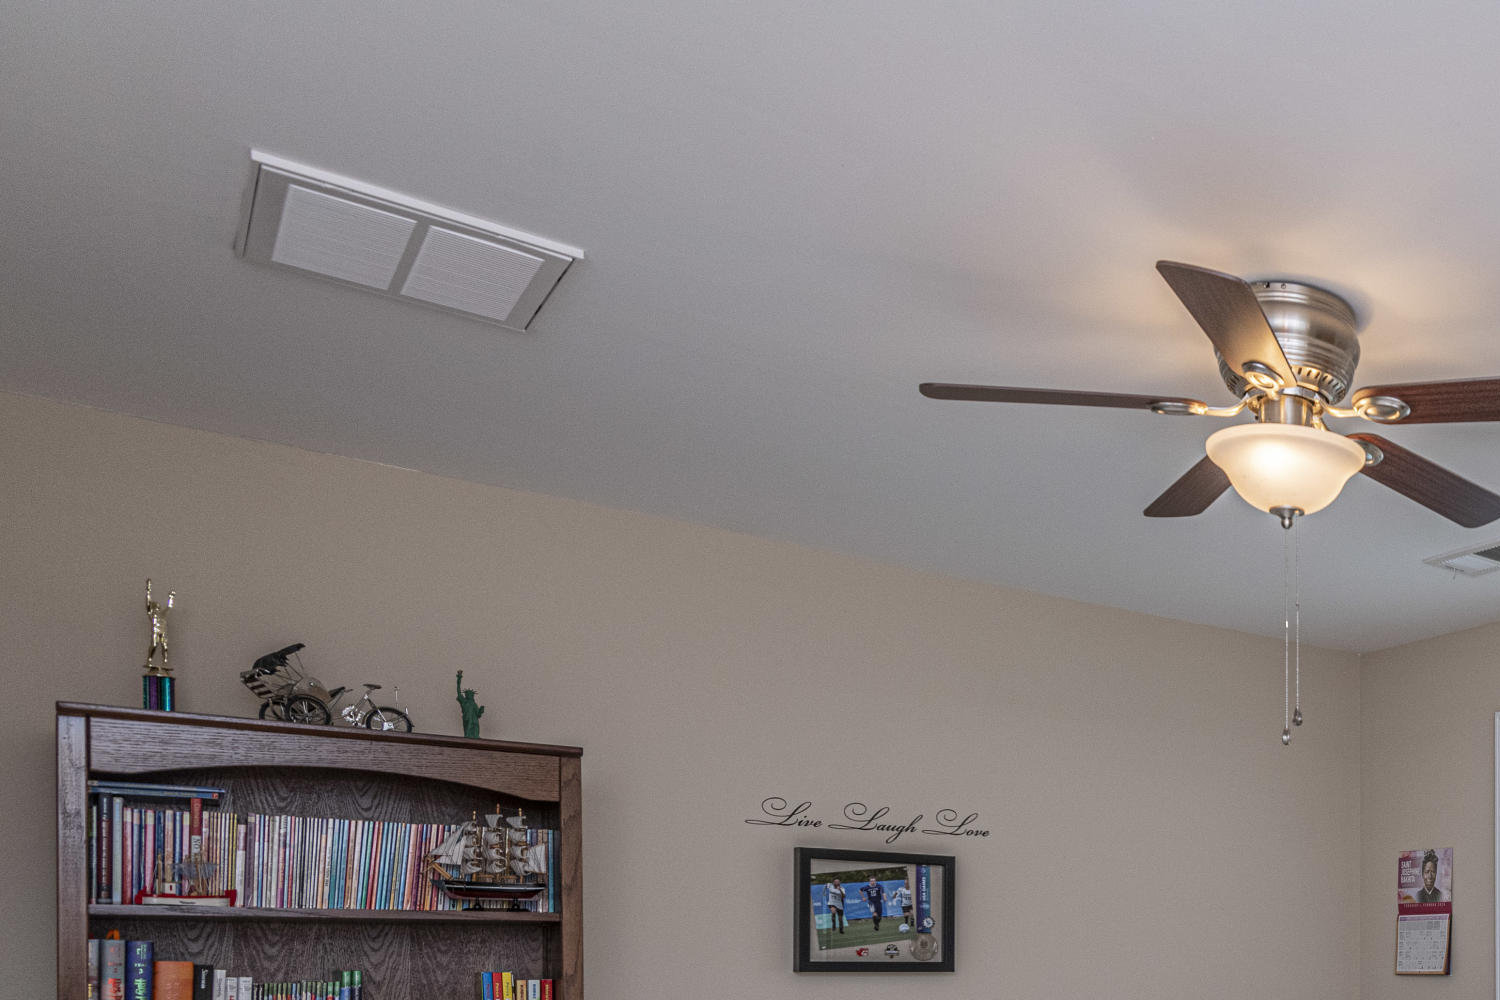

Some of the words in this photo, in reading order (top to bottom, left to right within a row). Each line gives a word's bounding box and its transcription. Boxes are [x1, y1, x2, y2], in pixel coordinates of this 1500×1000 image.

[745, 797, 822, 828] Live
[828, 802, 923, 844] Laugh
[922, 809, 990, 838] Love
